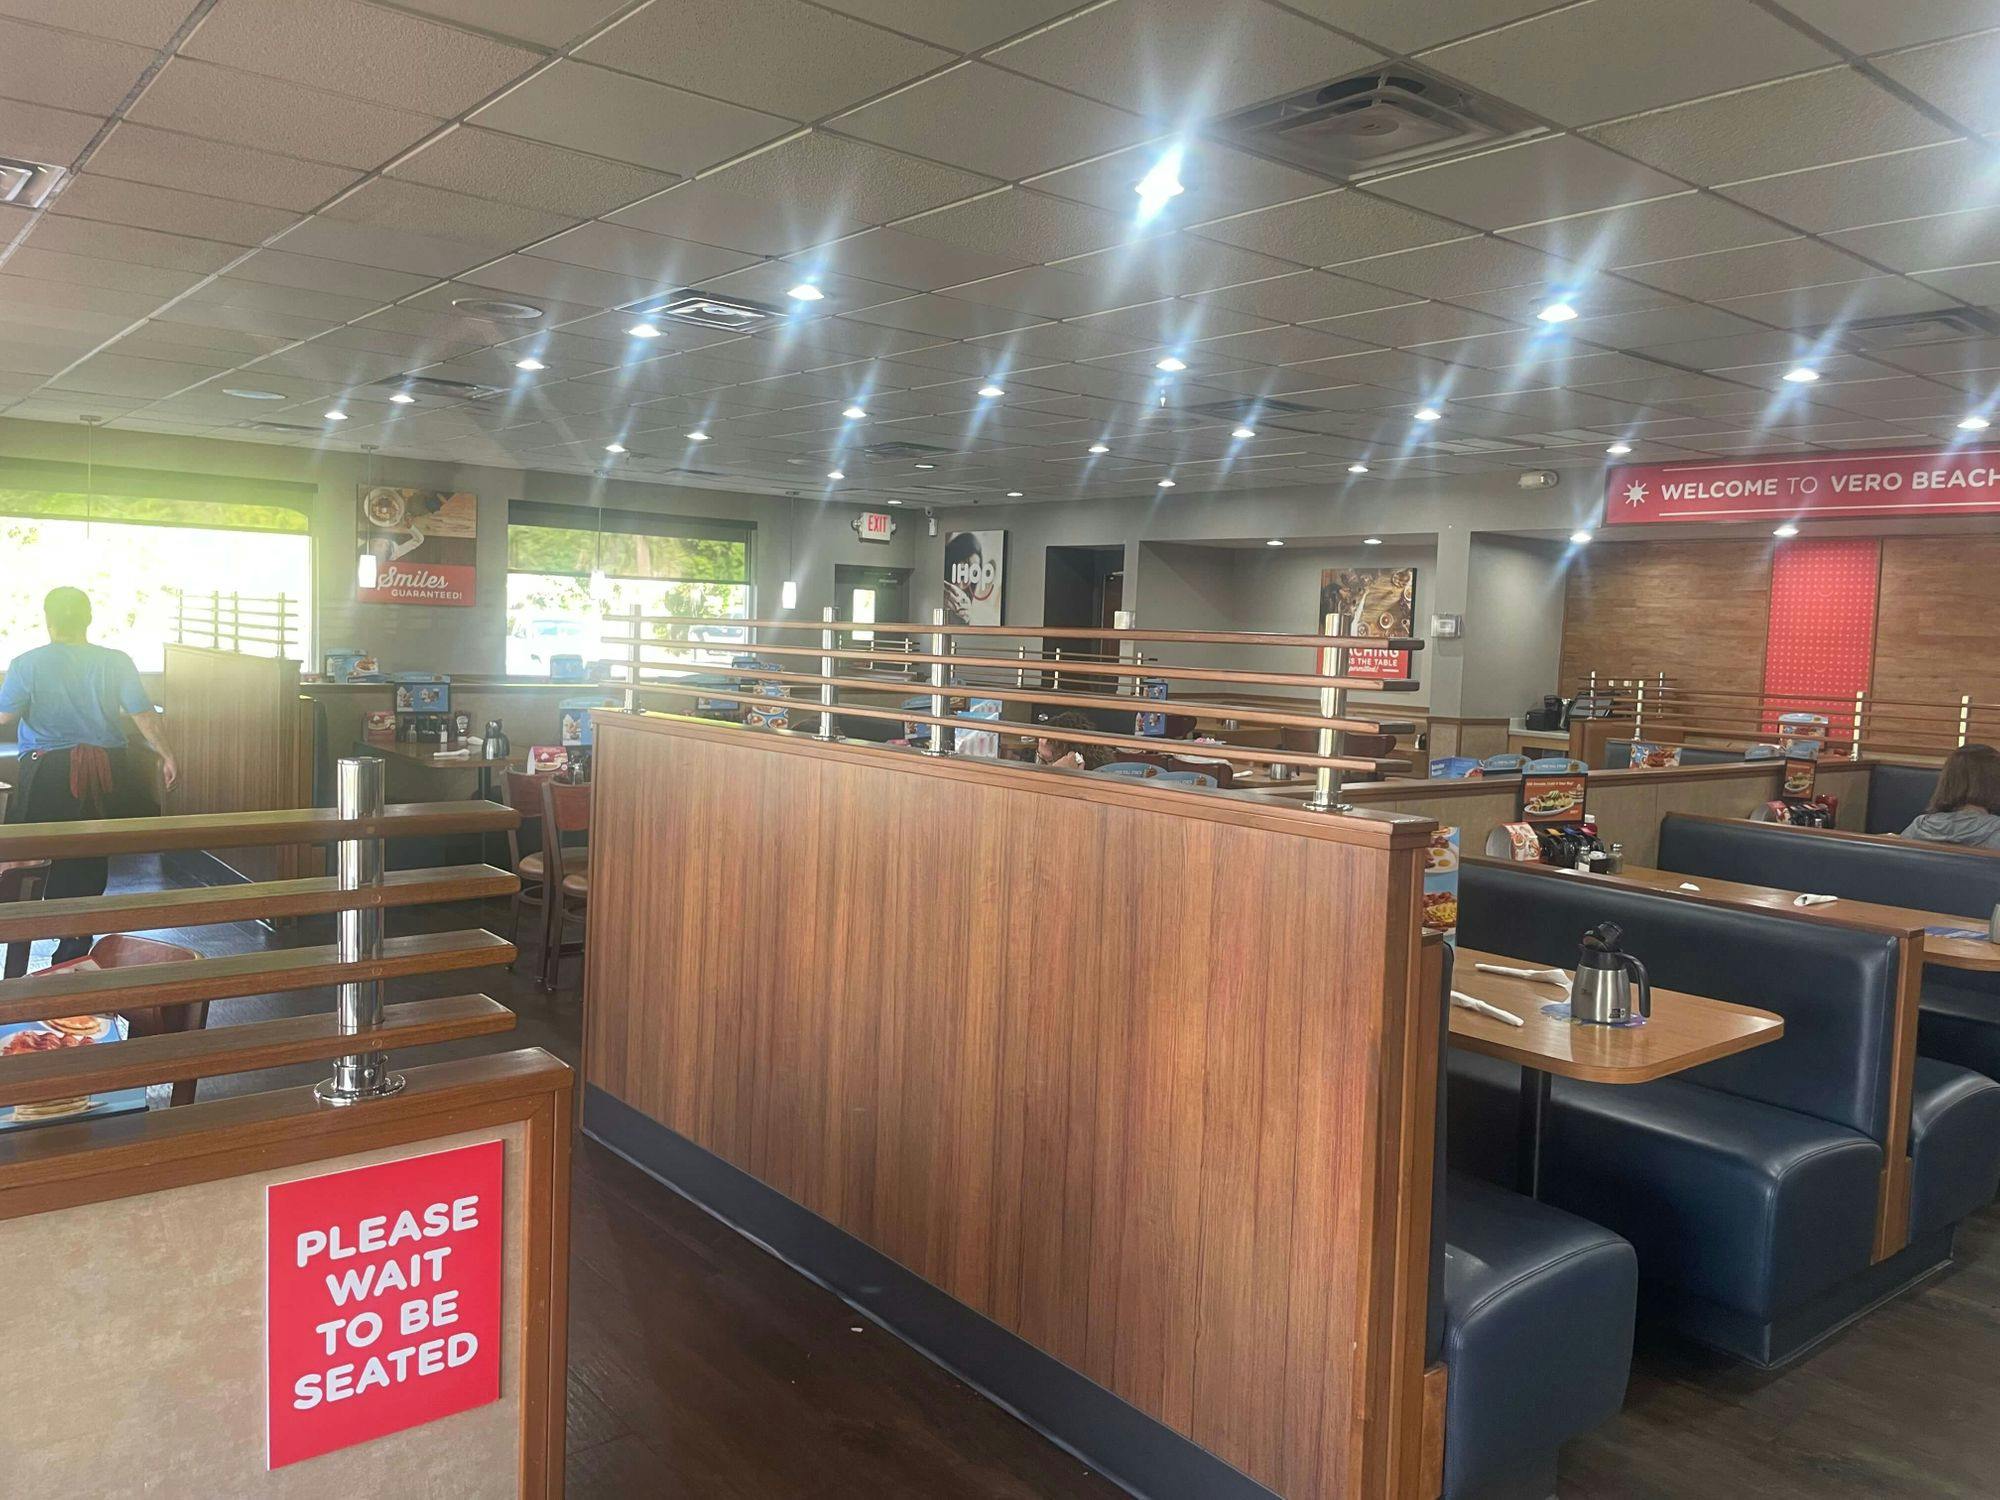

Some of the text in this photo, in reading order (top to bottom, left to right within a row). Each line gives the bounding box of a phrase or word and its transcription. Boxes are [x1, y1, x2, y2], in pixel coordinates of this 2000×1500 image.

[1661, 478, 1778, 500] WELCOME
[1787, 476, 1818, 495] TO
[1830, 472, 1902, 493] VERO
[868, 514, 888, 533] EXIT
[377, 566, 448, 590] Smiles
[391, 589, 462, 599] GUARANTEED!
[1349, 648, 1399, 659] CHING
[1358, 658, 1371, 666] THE
[1374, 659, 1398, 667] TABLE
[297, 1195, 479, 1268] PLEASE
[325, 1246, 452, 1306] WAIT
[315, 1290, 459, 1356] TO BE
[293, 1332, 478, 1410] SEATED
